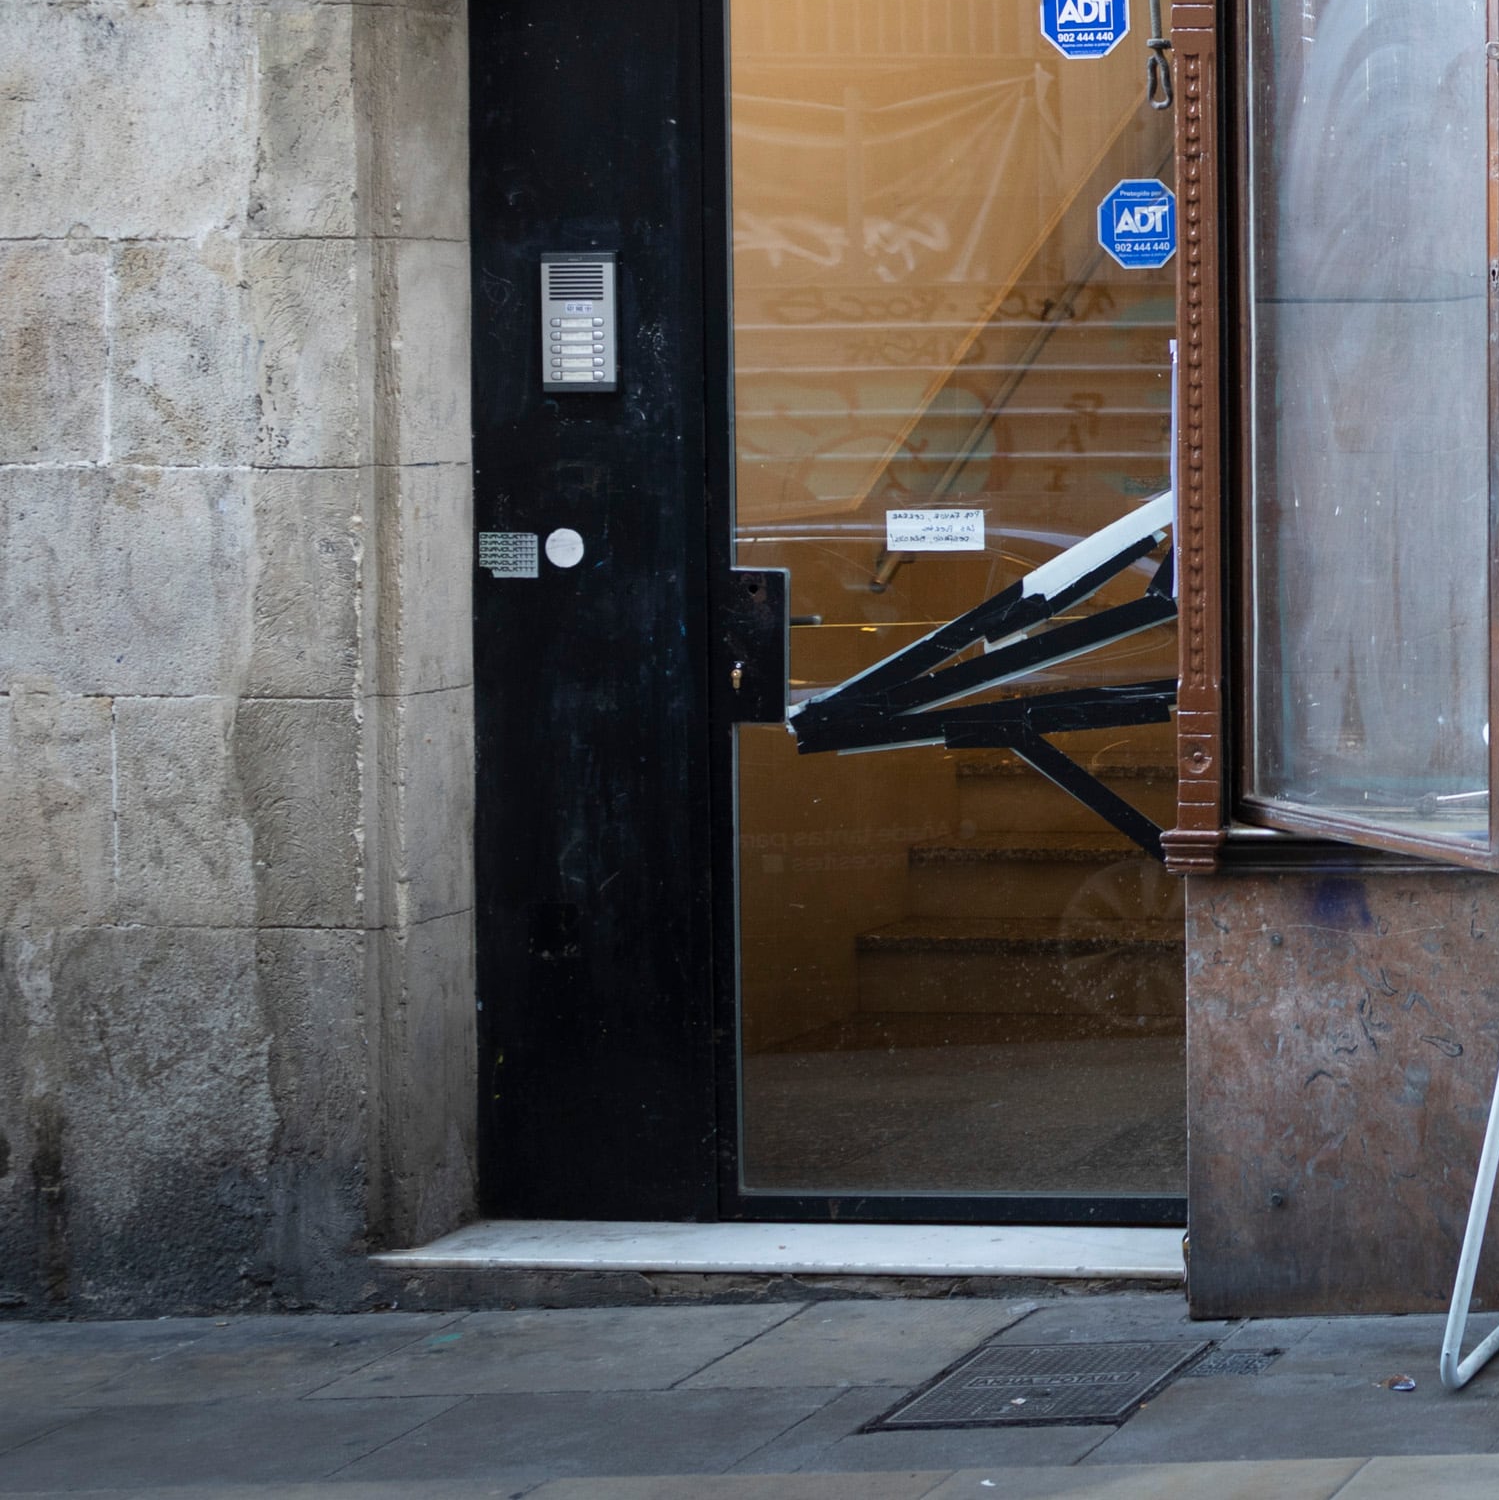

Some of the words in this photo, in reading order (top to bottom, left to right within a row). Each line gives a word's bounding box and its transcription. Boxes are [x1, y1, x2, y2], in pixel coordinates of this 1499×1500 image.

[1057, 32, 1075, 43] 902
[1076, 32, 1095, 42] 444
[1096, 31, 1114, 42] 440
[1120, 190, 1150, 198] Protegido
[1115, 205, 1169, 234] ADT
[1114, 243, 1132, 252] 902
[1132, 242, 1151, 252] 444
[1152, 241, 1170, 251] 440
